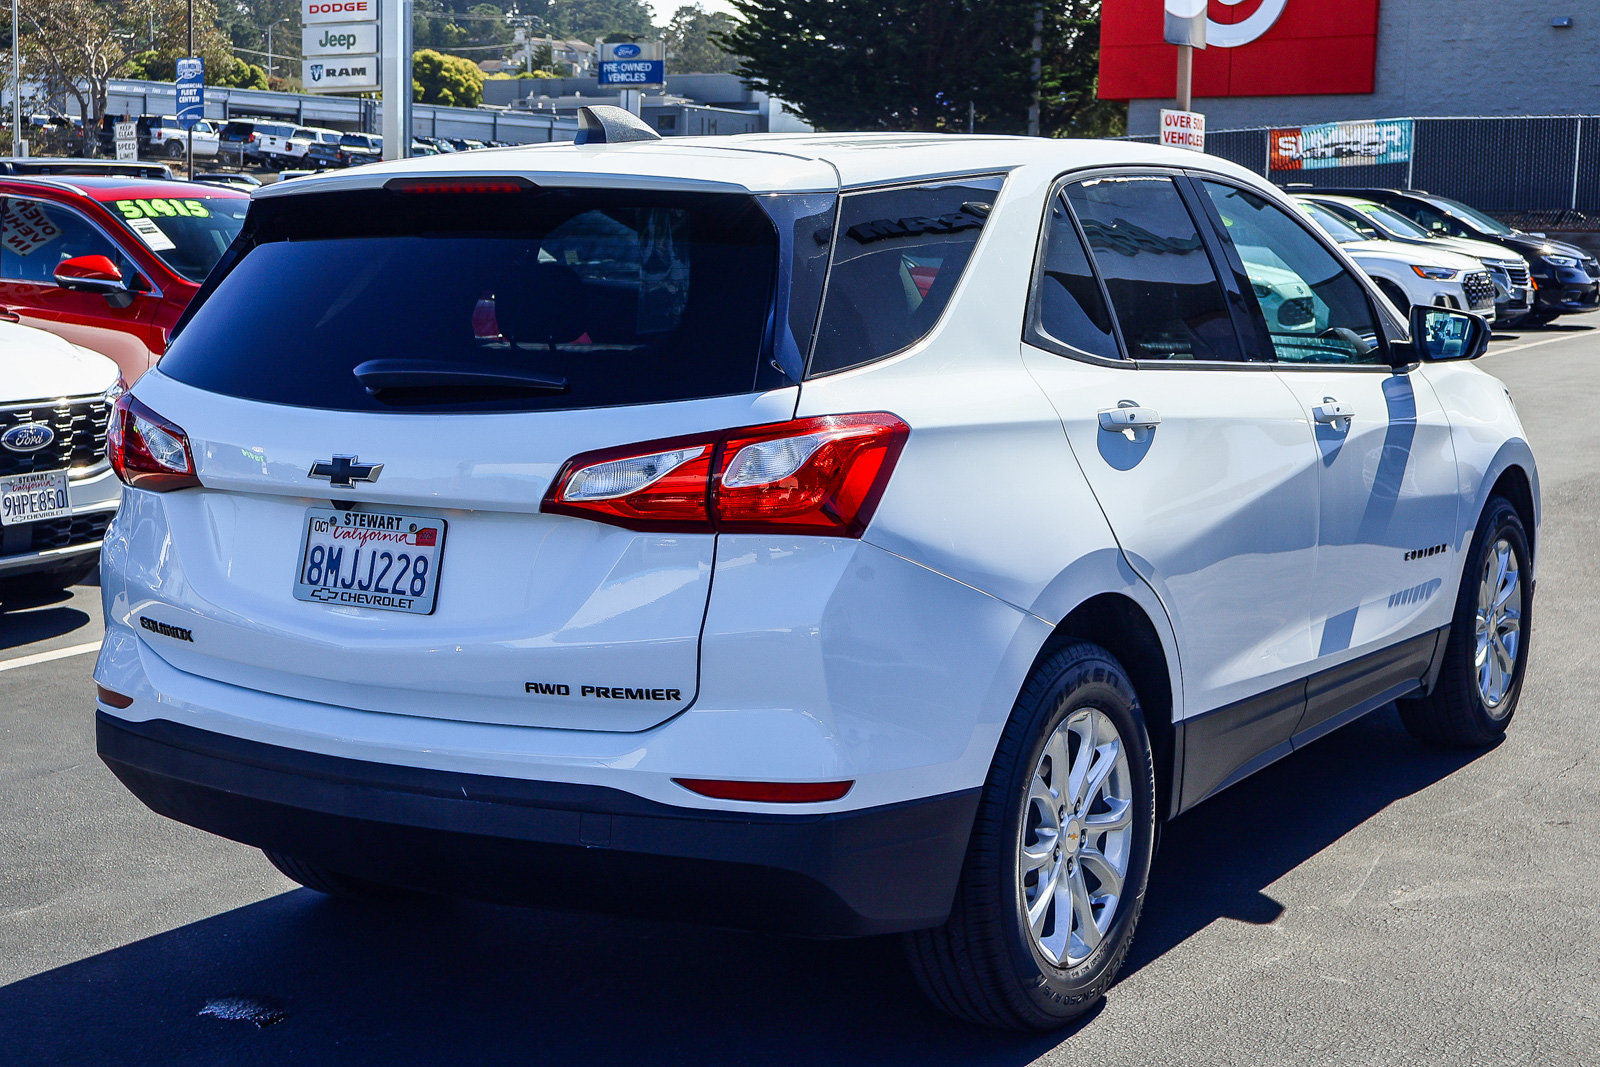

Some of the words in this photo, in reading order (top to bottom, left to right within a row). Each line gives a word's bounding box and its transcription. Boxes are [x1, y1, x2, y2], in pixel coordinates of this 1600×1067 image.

[309, 1, 368, 14] DODGE
[318, 30, 357, 50] Jeep
[617, 47, 634, 57] Ford
[325, 67, 367, 77] RAM
[602, 62, 653, 73] PRE-OWNED
[607, 72, 647, 82] VEHICLES
[178, 96, 200, 104] CENTER
[1164, 113, 1192, 129] OVER
[1163, 130, 1203, 147] VEHICLES
[117, 143, 136, 151] SPEED
[119, 152, 134, 160] LIMIT
[15, 429, 45, 447] Ford
[18, 473, 49, 484] STEWART
[3, 488, 65, 517] 9HPE850
[26, 510, 64, 520] CHEVROLET
[344, 512, 403, 531] STEWART
[333, 525, 412, 548] California
[1404, 543, 1448, 561] EQUINOX
[306, 545, 429, 597] 8MJJ228
[340, 591, 415, 609] CHEVROLET
[139, 615, 194, 643] EQUINOX
[525, 681, 570, 696] AWD
[580, 685, 682, 701] PREMIER
